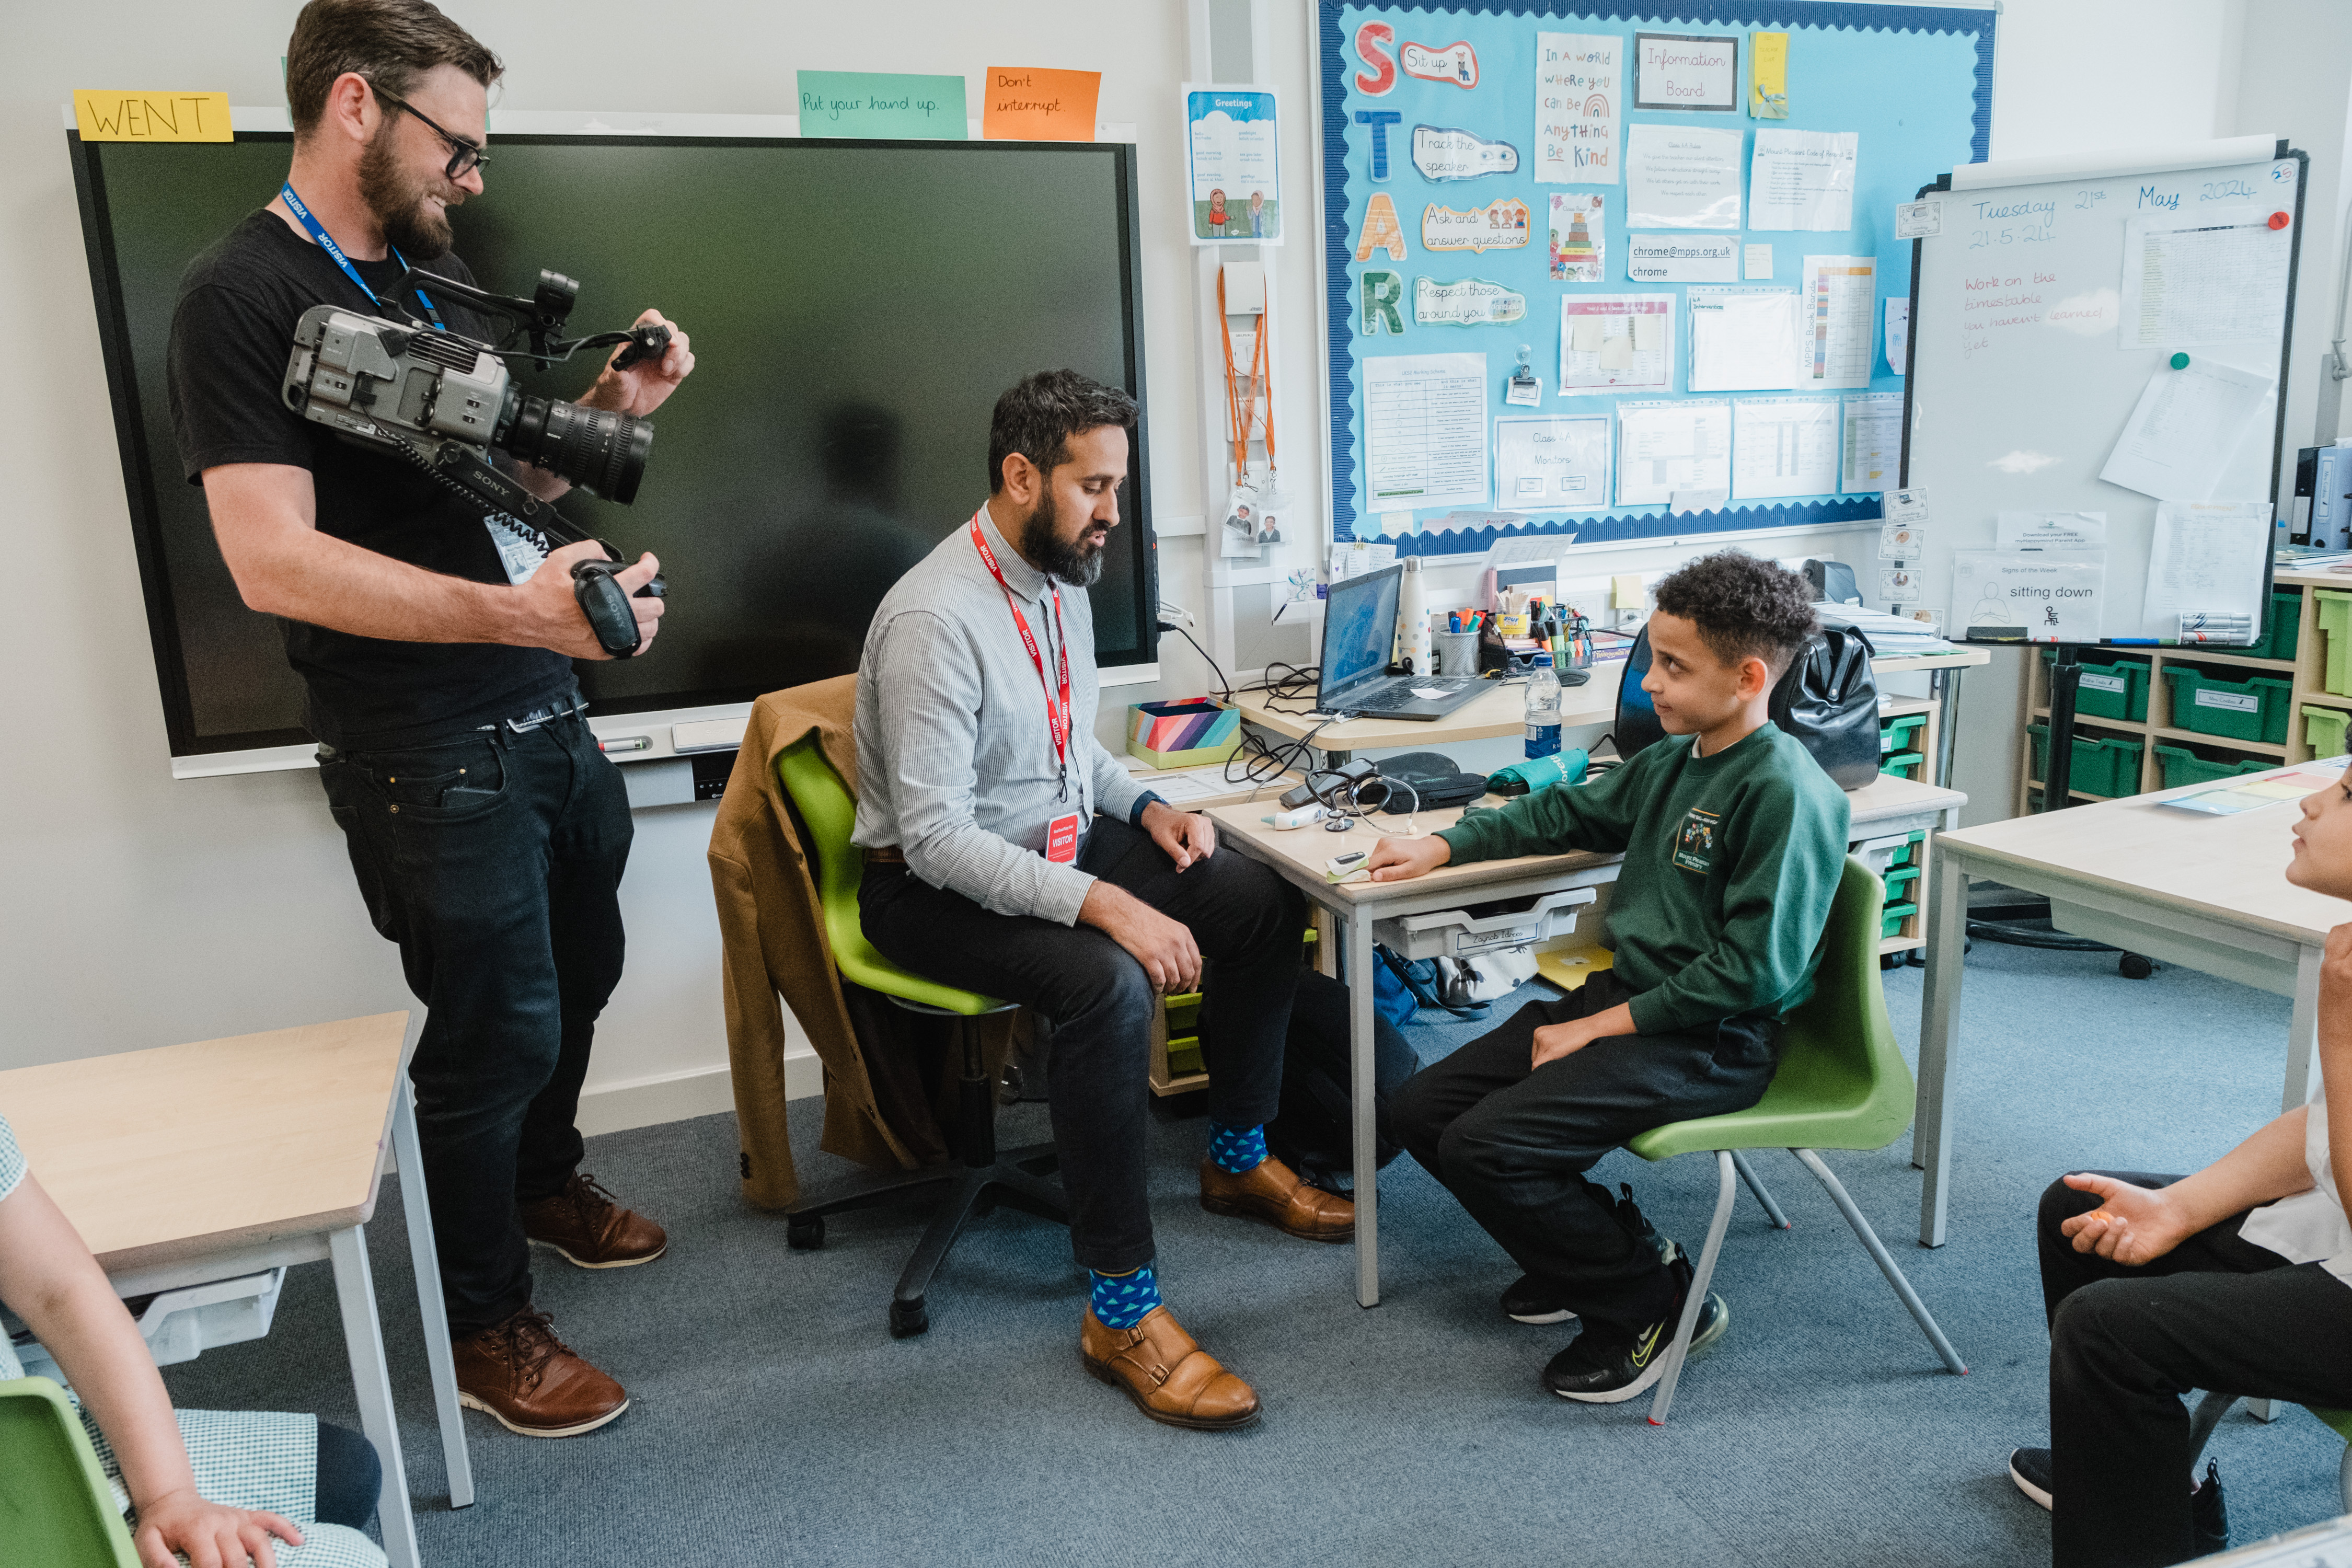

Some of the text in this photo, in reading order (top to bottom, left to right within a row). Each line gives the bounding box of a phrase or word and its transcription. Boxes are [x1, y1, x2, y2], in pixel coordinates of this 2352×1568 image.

[1357, 24, 1395, 94] S
[1407, 49, 1447, 73] Sit up
[1546, 49, 1557, 62] In
[1562, 52, 1571, 61] A
[1647, 48, 1726, 71] Information
[997, 74, 1032, 88] Don't
[1666, 80, 1705, 97] Board
[803, 93, 940, 121] Put your hand up.
[996, 98, 1067, 117] interrupt.
[1215, 98, 1252, 109] Greetings
[1566, 98, 1581, 110] Be
[87, 97, 210, 136] WENT
[1355, 111, 1401, 179] T
[1417, 129, 1475, 151] Track the
[1547, 144, 1564, 158] Be
[1784, 148, 1806, 156] Pleasant
[1819, 150, 1825, 159] of
[1425, 159, 1469, 176] speaker
[283, 188, 308, 220] VISITOR
[1972, 180, 2257, 228] Tuesday 21st May 2024
[1426, 206, 1479, 225] Ask and
[1356, 194, 1407, 261] A
[318, 233, 348, 269] VISITOR
[1426, 232, 1527, 250] answer questions
[1633, 246, 1731, 258] chrome@mpps.org.uk
[1633, 267, 1668, 276] chrome
[1966, 272, 2056, 291] Work on the
[1418, 280, 1500, 302] Respect those
[1363, 272, 1405, 333] R
[1965, 292, 2043, 311] timestable
[1418, 305, 1485, 322] around you
[1962, 307, 2102, 340] you haven't learned
[1804, 280, 1816, 368] MPPS Book Bands
[1963, 338, 1989, 360] yet
[1533, 432, 1572, 443] Class 4A
[1535, 455, 1572, 465] Monitors
[472, 470, 510, 496] SONY
[980, 544, 998, 572] VISITOR
[2010, 586, 2093, 600] sitting down
[605, 594, 626, 628] SONY
[1022, 628, 1037, 658] VISITOR
[1051, 717, 1063, 746] VISITOR
[1052, 834, 1073, 848] VISITOR
[1473, 930, 1524, 944] Zaynab Idrees
